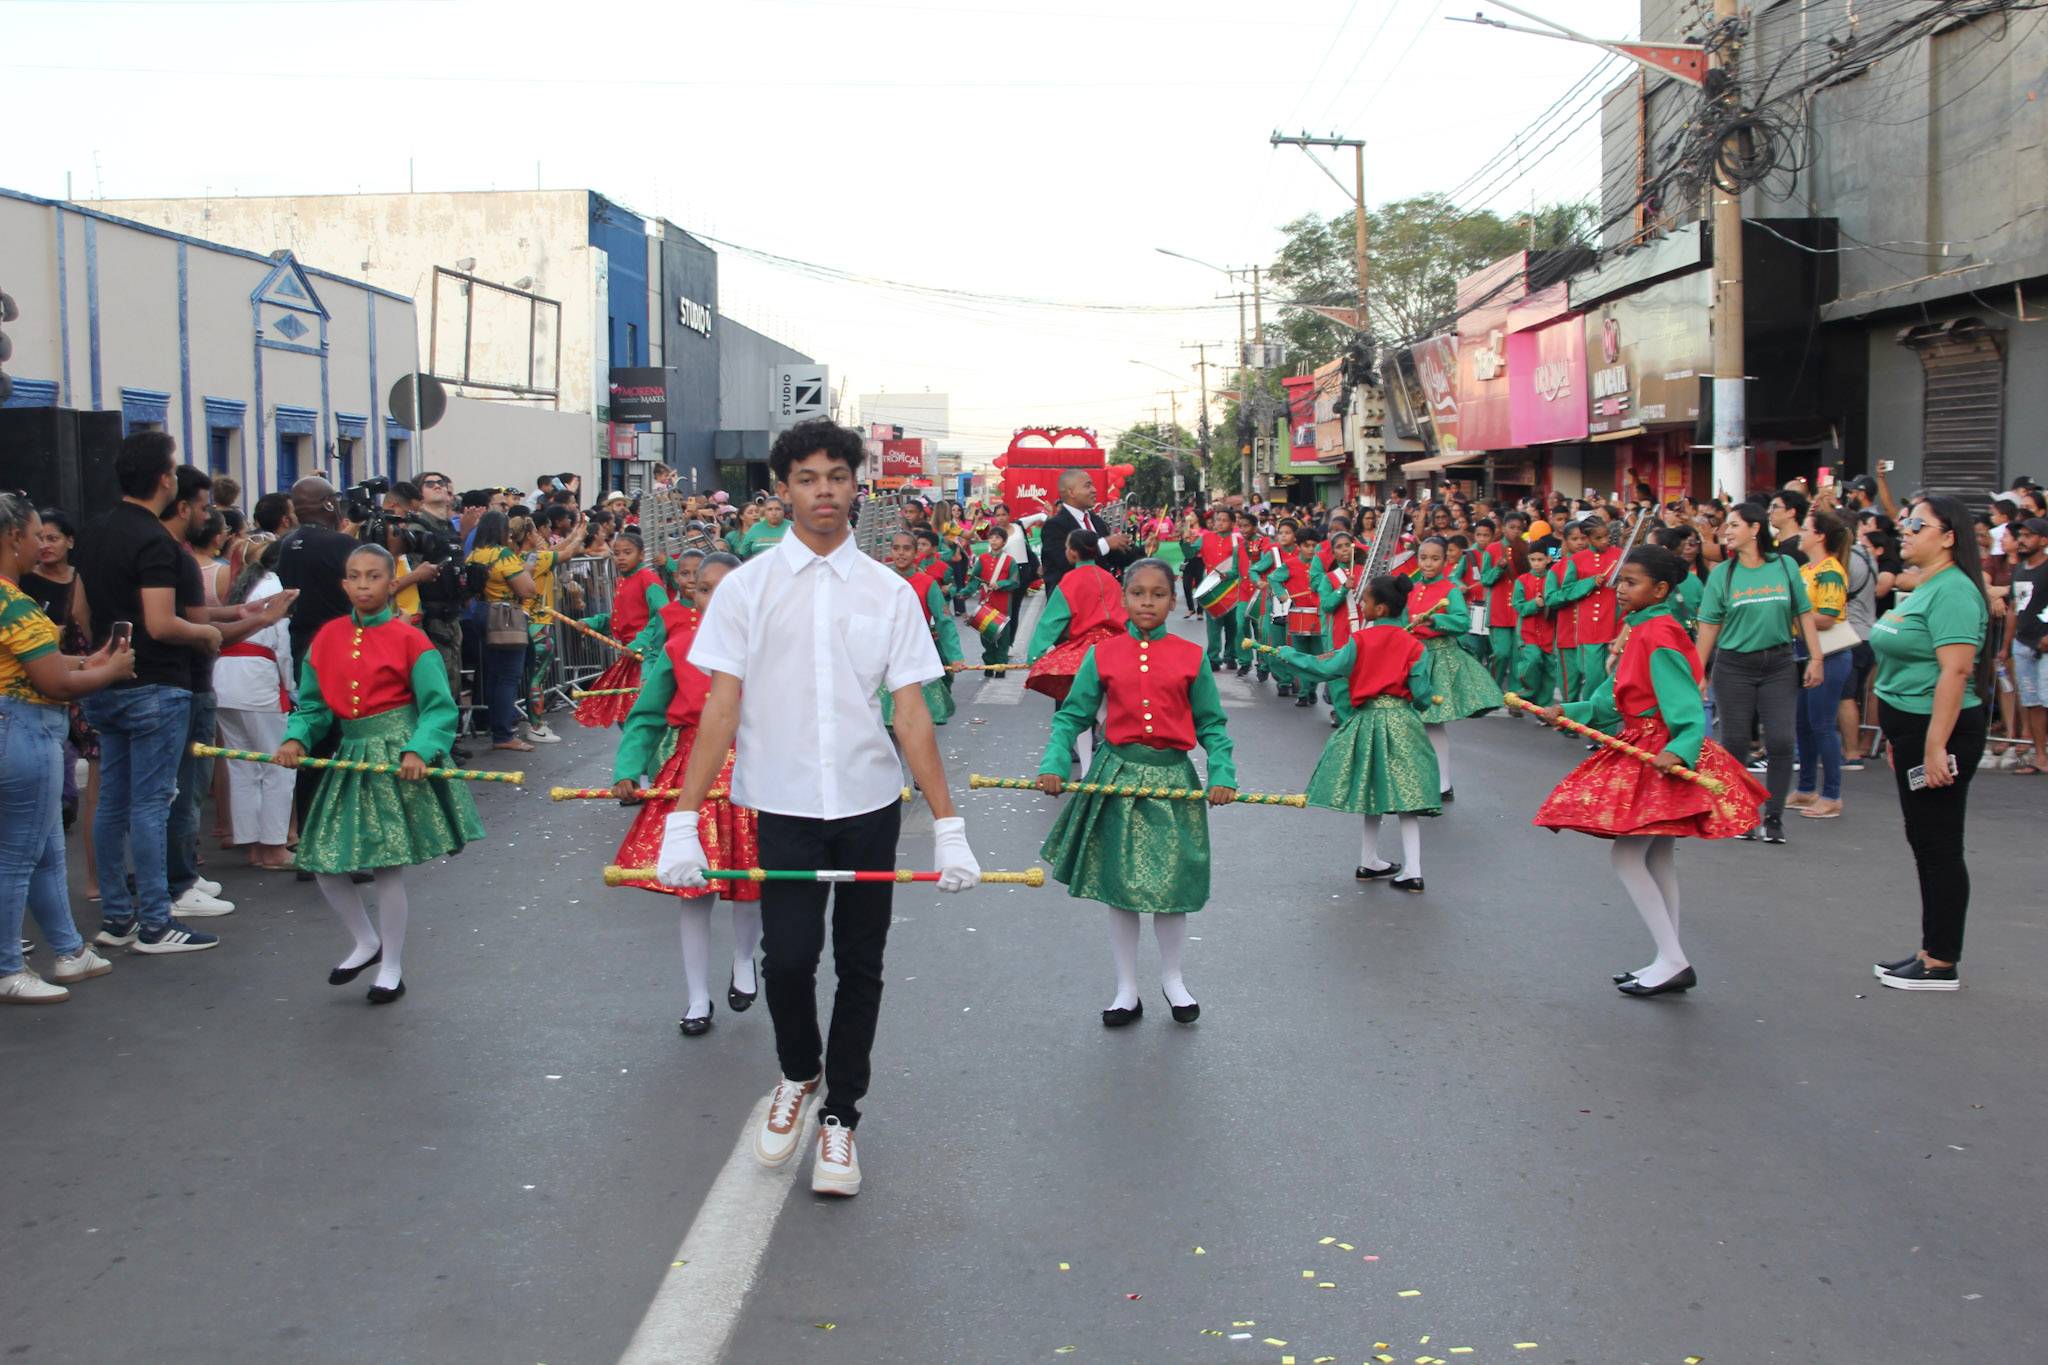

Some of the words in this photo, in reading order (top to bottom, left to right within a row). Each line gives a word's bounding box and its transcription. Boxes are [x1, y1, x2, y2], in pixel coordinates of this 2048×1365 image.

[680, 296, 706, 334] STUDIO
[623, 385, 664, 397] MORENA
[783, 374, 791, 416] STUDIO
[883, 454, 921, 466] TROPICAL
[1016, 484, 1048, 499] Mulher
